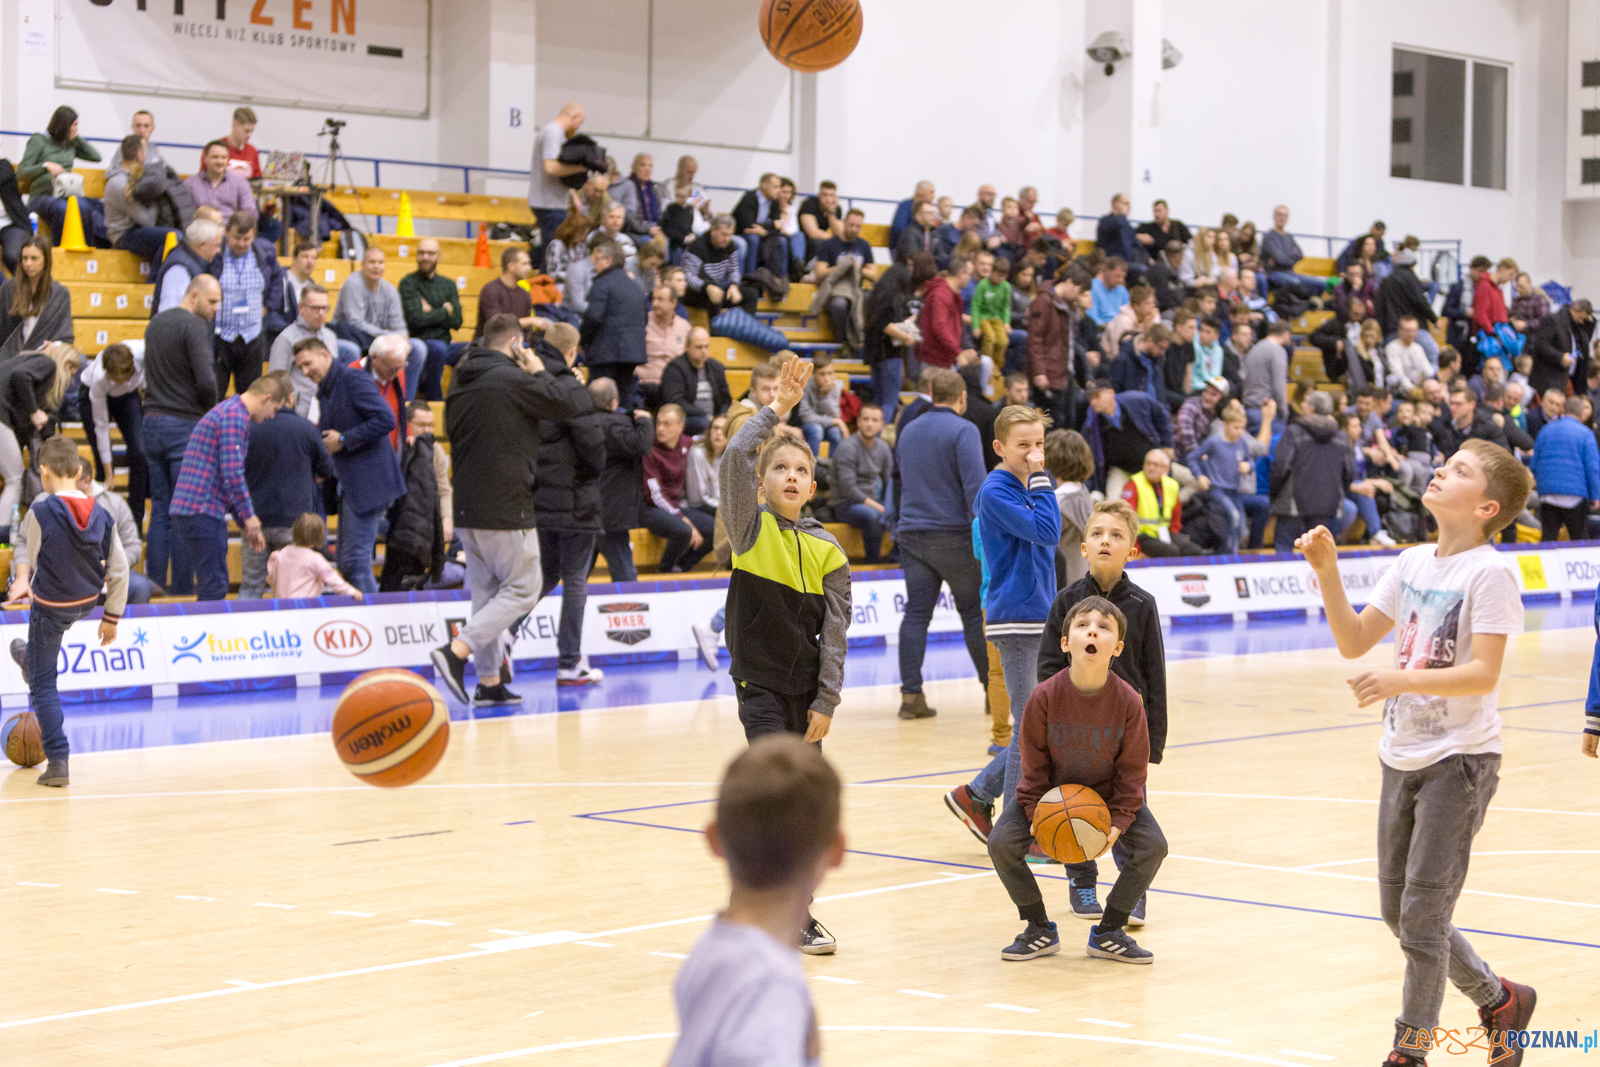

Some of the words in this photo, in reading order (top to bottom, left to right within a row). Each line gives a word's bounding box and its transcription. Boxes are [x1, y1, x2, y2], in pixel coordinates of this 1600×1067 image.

[252, 31, 284, 46] KLUB
[291, 34, 355, 52] SPORTOWY
[510, 107, 521, 127] B
[1142, 168, 1152, 183] A
[1252, 576, 1305, 596] NICKEL
[607, 614, 646, 629] JOKER
[207, 629, 301, 653] funclub
[323, 628, 363, 650] KIA
[384, 623, 438, 646] DELIK
[57, 642, 145, 675] OZnan
[211, 653, 246, 662] biuro
[348, 715, 412, 756] molten
